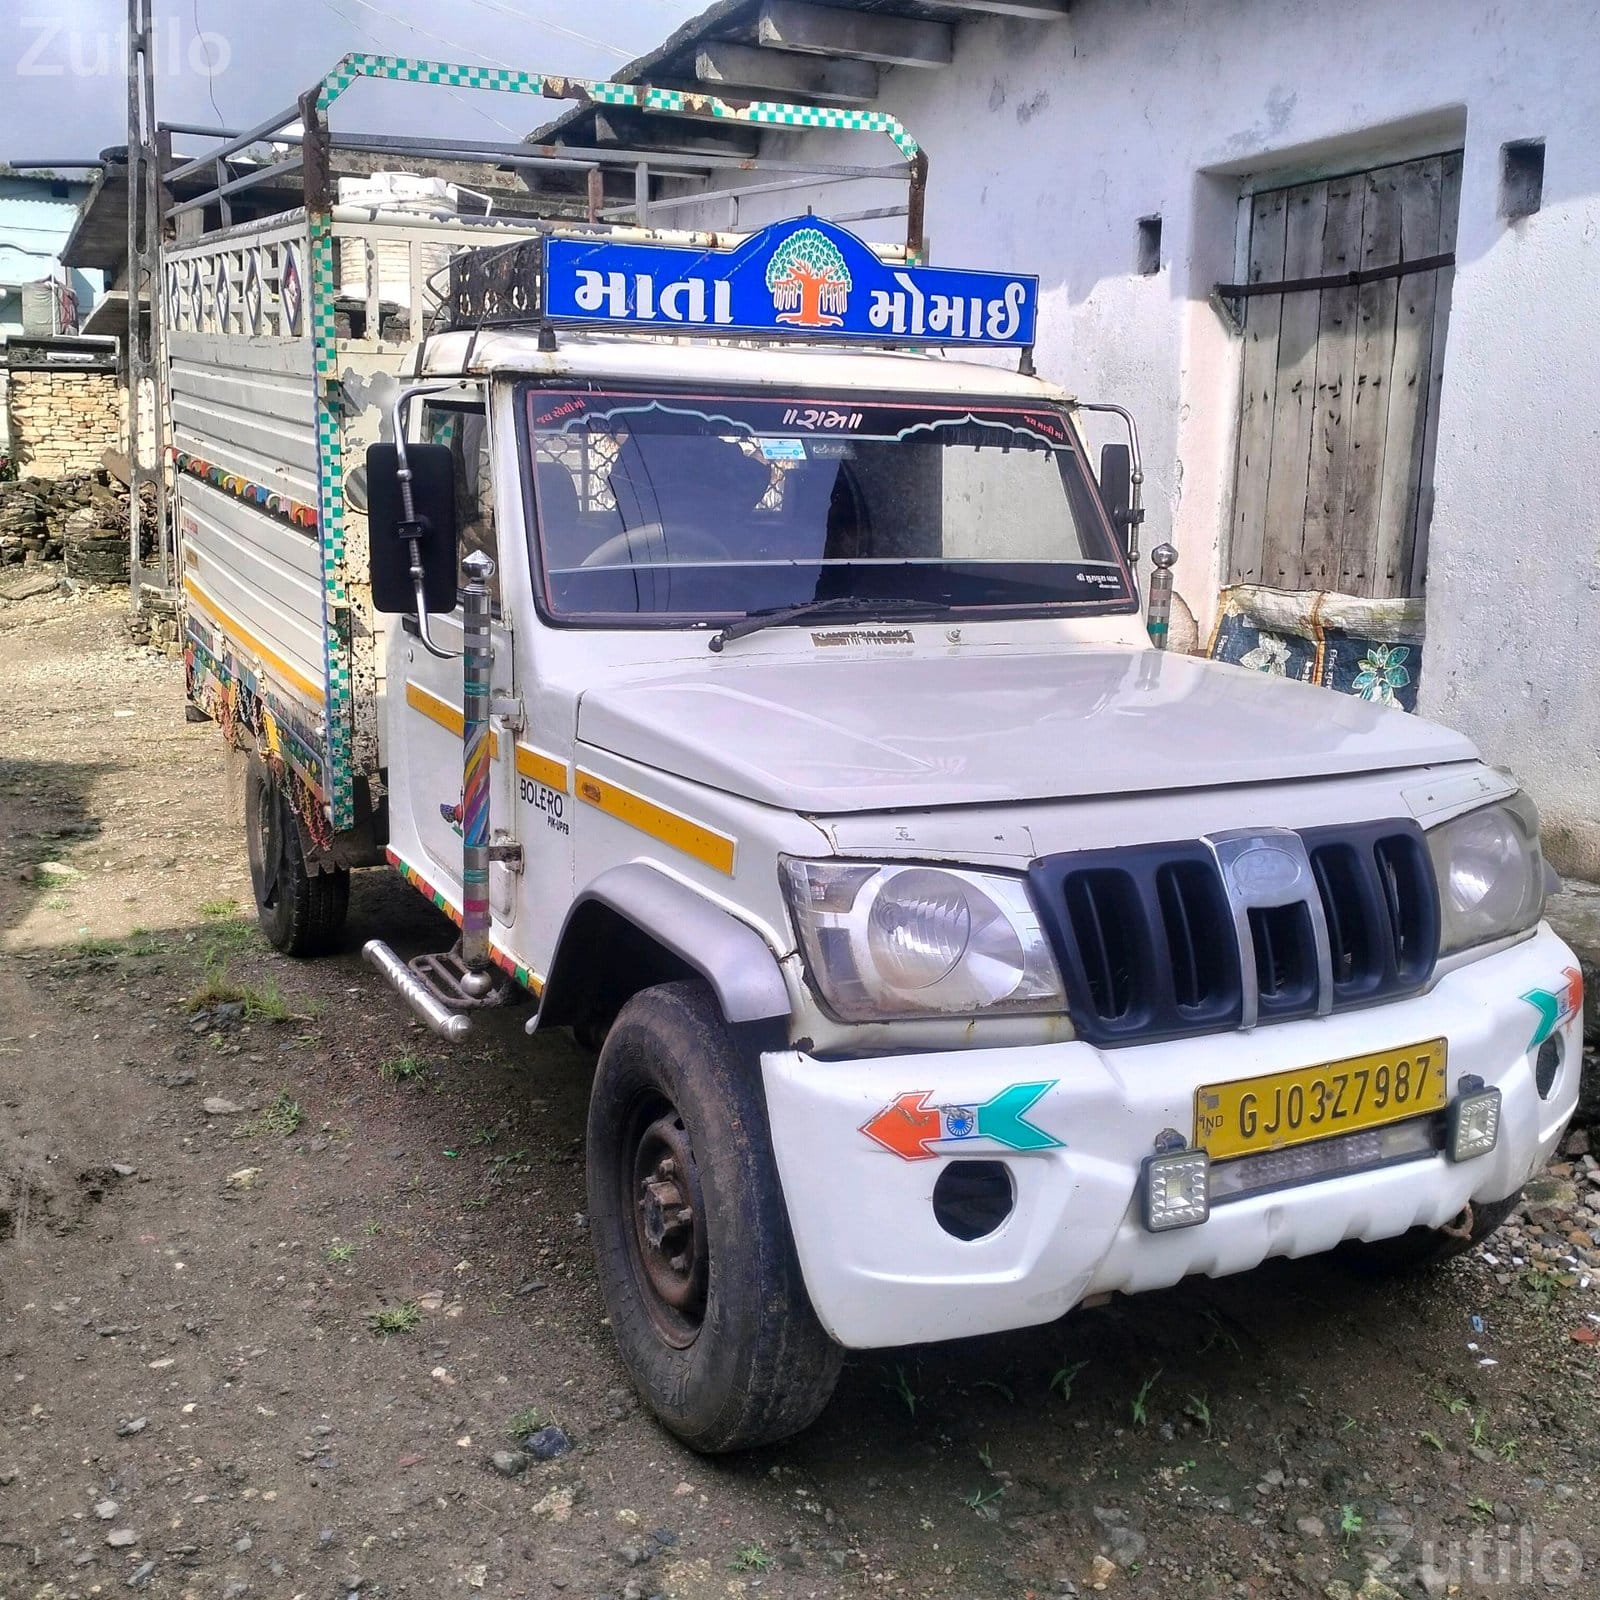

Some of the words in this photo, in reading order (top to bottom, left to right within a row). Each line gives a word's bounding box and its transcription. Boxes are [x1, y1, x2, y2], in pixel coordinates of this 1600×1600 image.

[574, 269, 734, 324] માતા
[868, 272, 1026, 340] મોમાઈ
[520, 777, 563, 818] BOLERO
[1201, 1114, 1224, 1129] IND
[1239, 1055, 1431, 1138] GJ03Z7987
